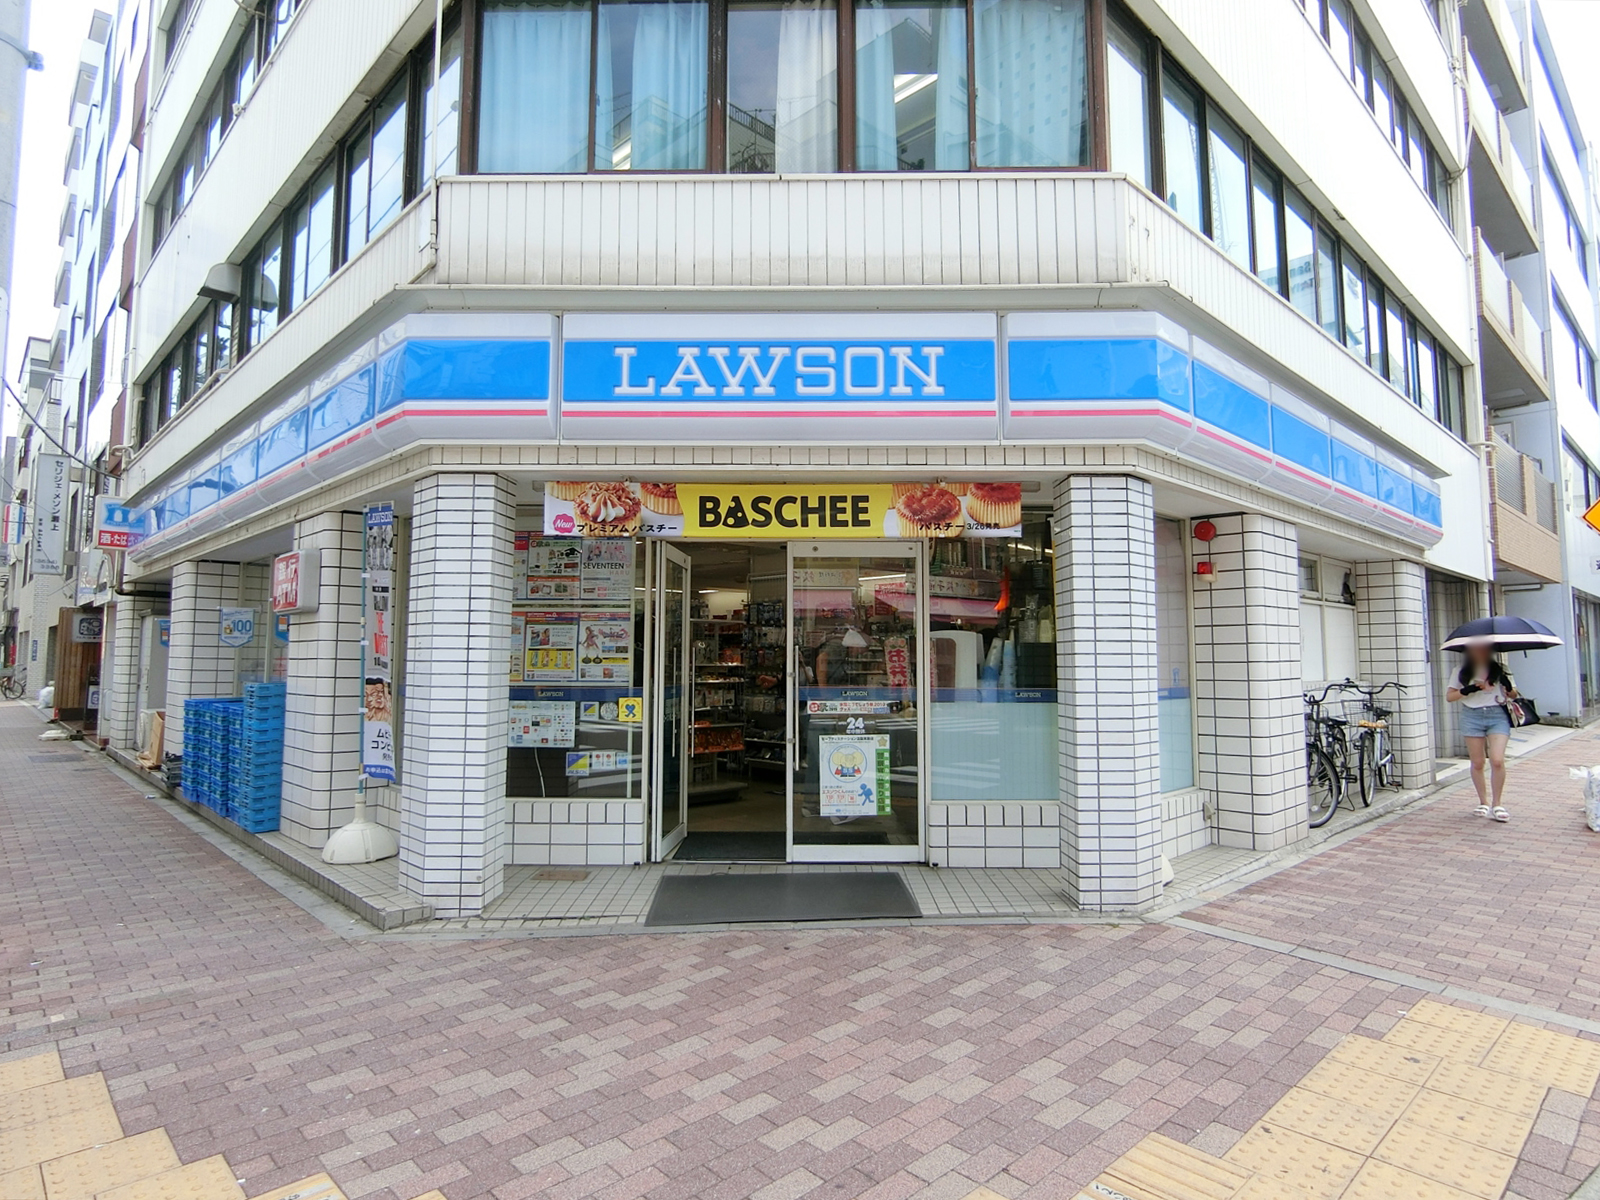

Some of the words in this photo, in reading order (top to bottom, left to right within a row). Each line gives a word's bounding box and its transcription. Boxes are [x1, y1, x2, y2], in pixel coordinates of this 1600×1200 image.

[613, 346, 945, 396] LAWSON
[367, 511, 393, 524] LAWSON
[698, 495, 871, 529] BASCHEE
[555, 519, 573, 528] New
[919, 522, 965, 531] バスチー
[278, 559, 298, 580] 銀行
[582, 562, 625, 570] SEVENTEEN
[275, 582, 297, 606] ATM
[231, 619, 252, 633] 100
[846, 717, 865, 729] 24
